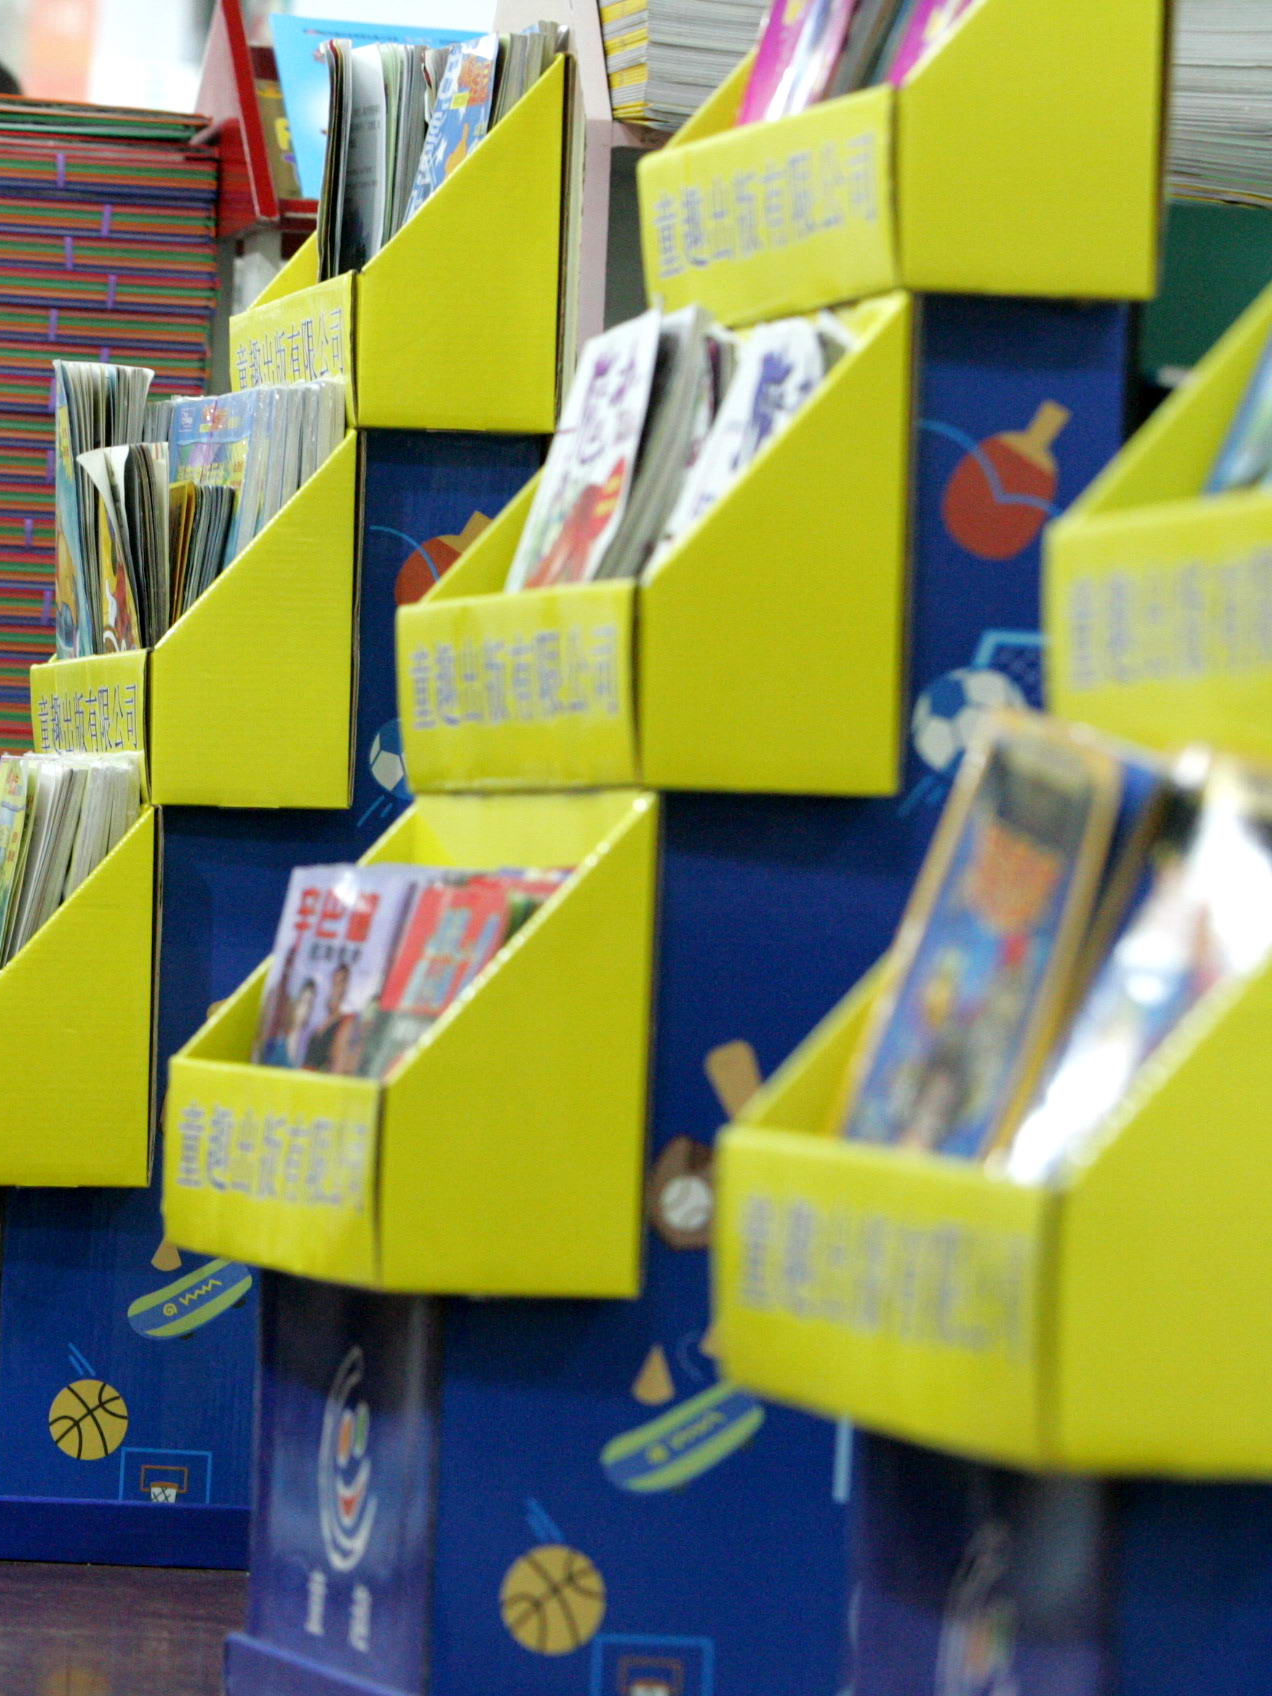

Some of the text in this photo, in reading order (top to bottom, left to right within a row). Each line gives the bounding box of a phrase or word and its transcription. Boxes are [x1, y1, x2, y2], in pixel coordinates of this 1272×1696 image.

[38, 684, 139, 755] 童趣出版有限公司
